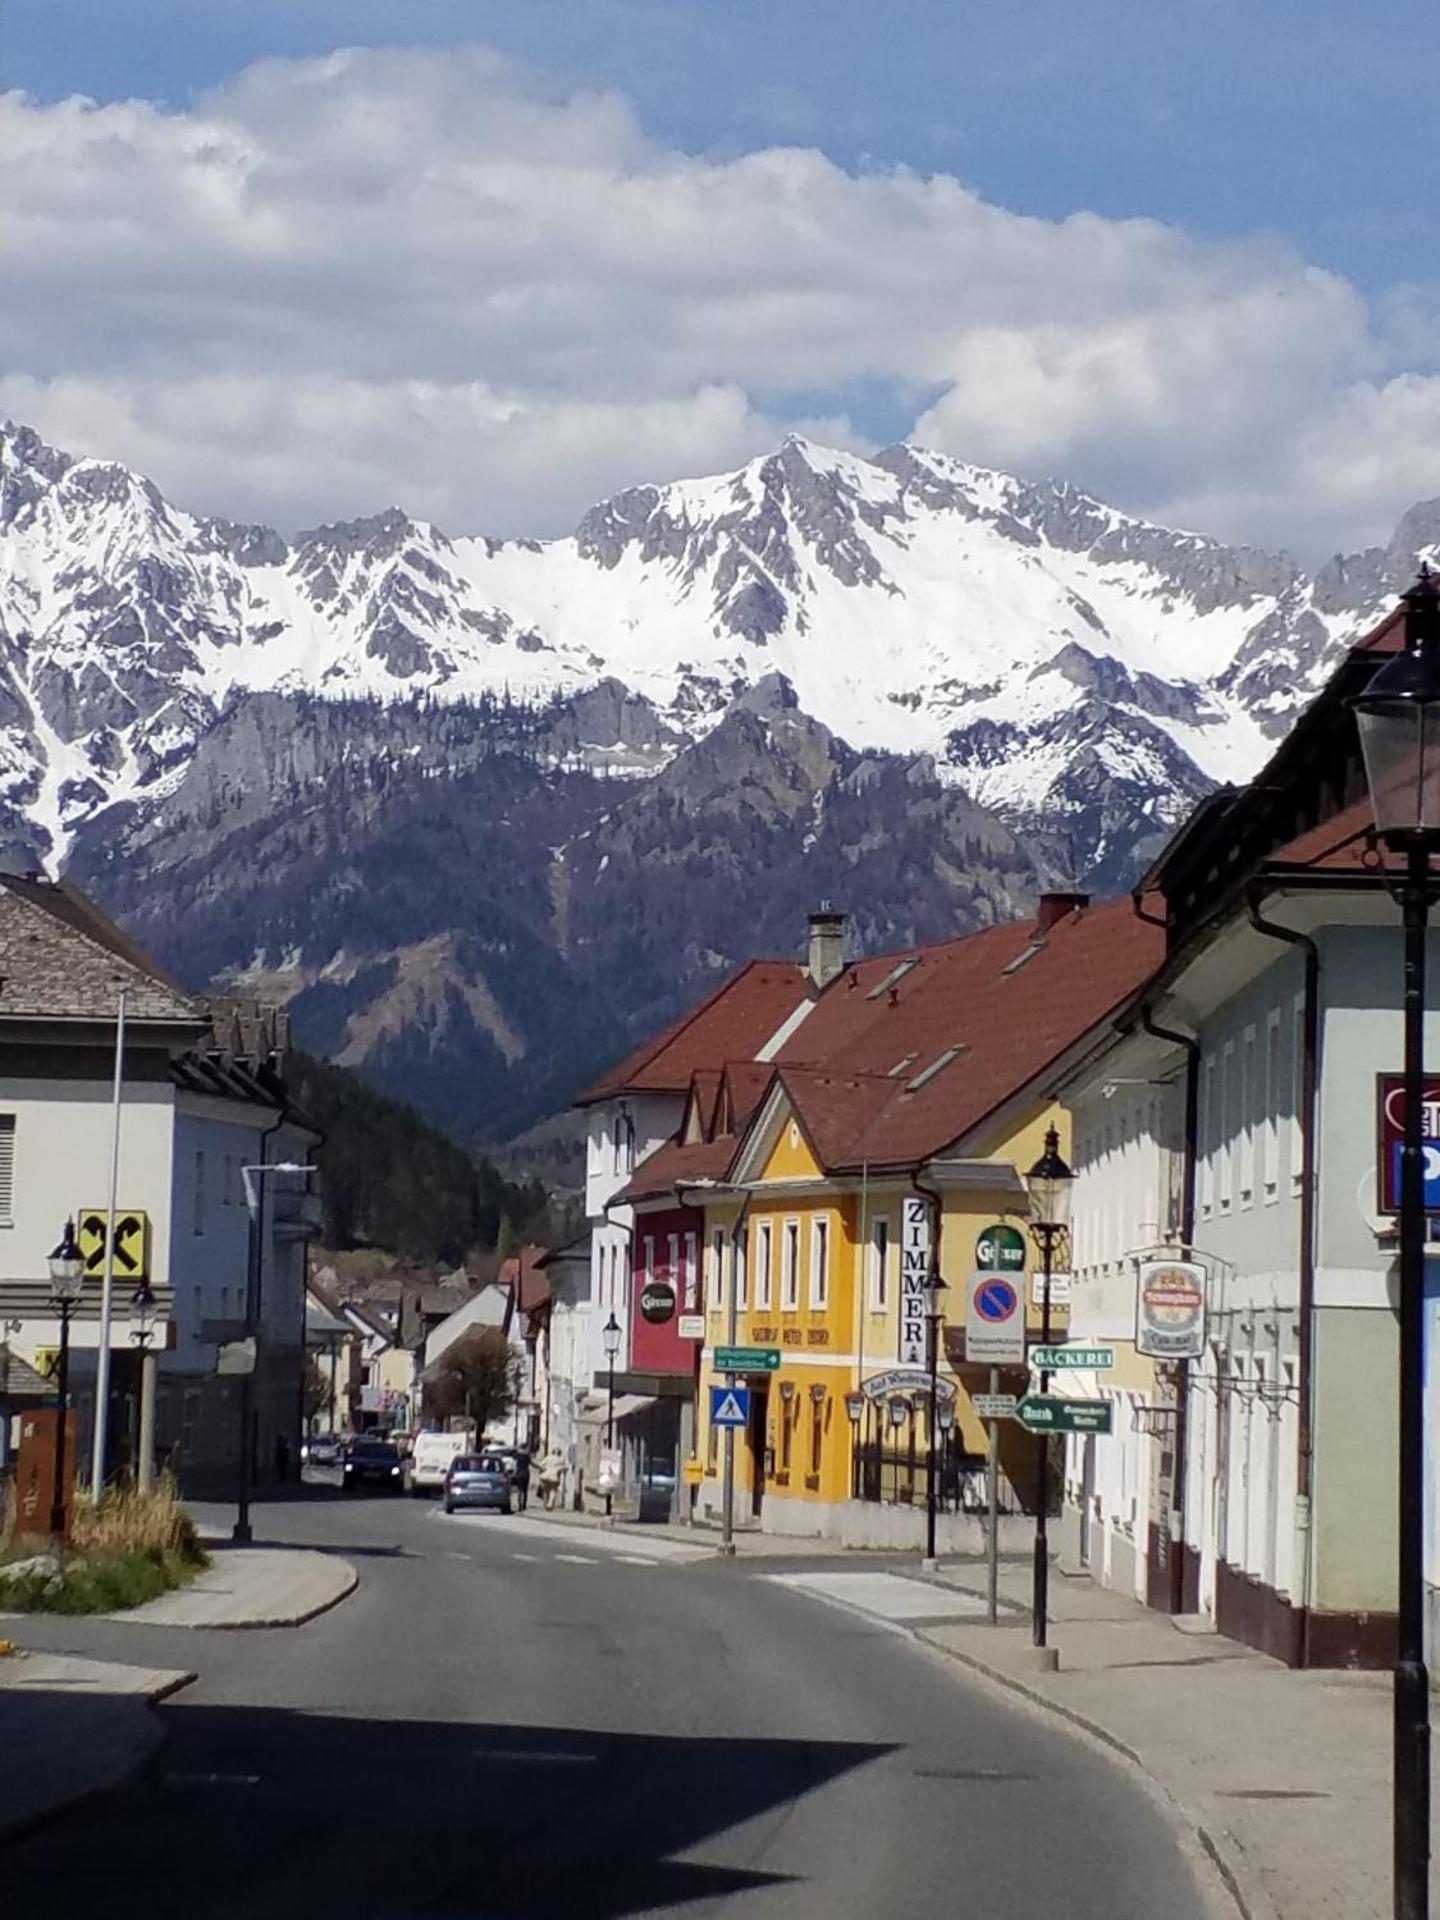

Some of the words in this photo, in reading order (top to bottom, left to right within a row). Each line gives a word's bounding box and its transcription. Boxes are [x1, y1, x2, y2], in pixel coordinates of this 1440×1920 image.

[977, 1240, 1023, 1262] Göser
[903, 1201, 926, 1342] ZIMMER
[1034, 1348, 1111, 1365] BÄCKEREI
